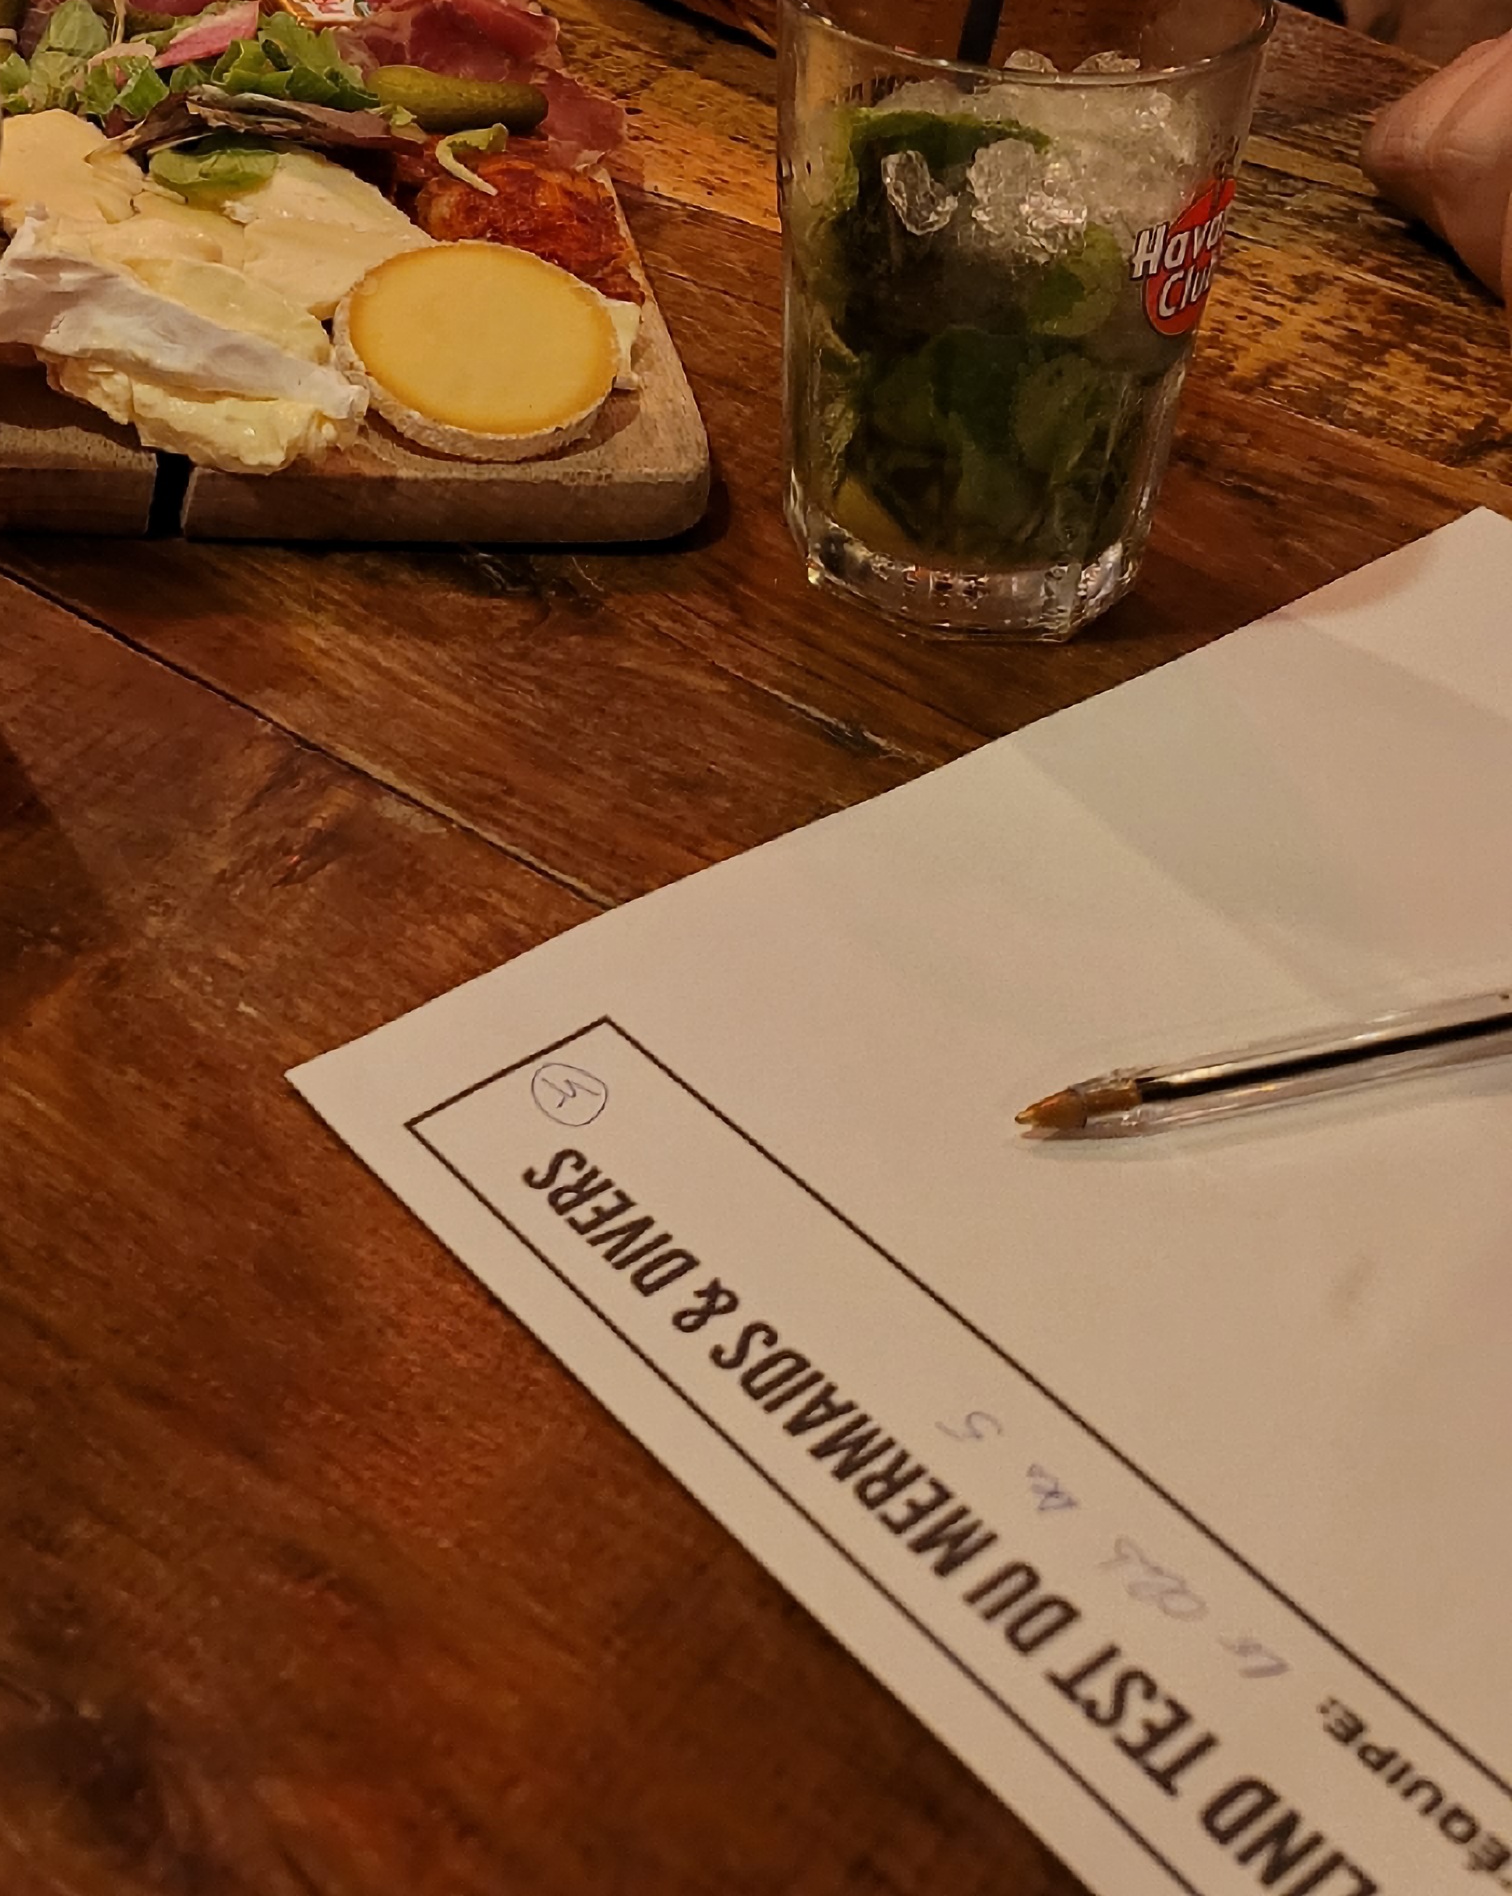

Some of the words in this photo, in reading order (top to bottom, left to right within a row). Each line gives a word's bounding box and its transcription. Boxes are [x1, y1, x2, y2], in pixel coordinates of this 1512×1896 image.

[522, 1148, 701, 1297] DIVERS
[672, 1277, 740, 1333] &
[709, 1320, 998, 1578] MERMAIDS
[962, 1561, 1081, 1656] DU
[1045, 1643, 1219, 1798] TEST
